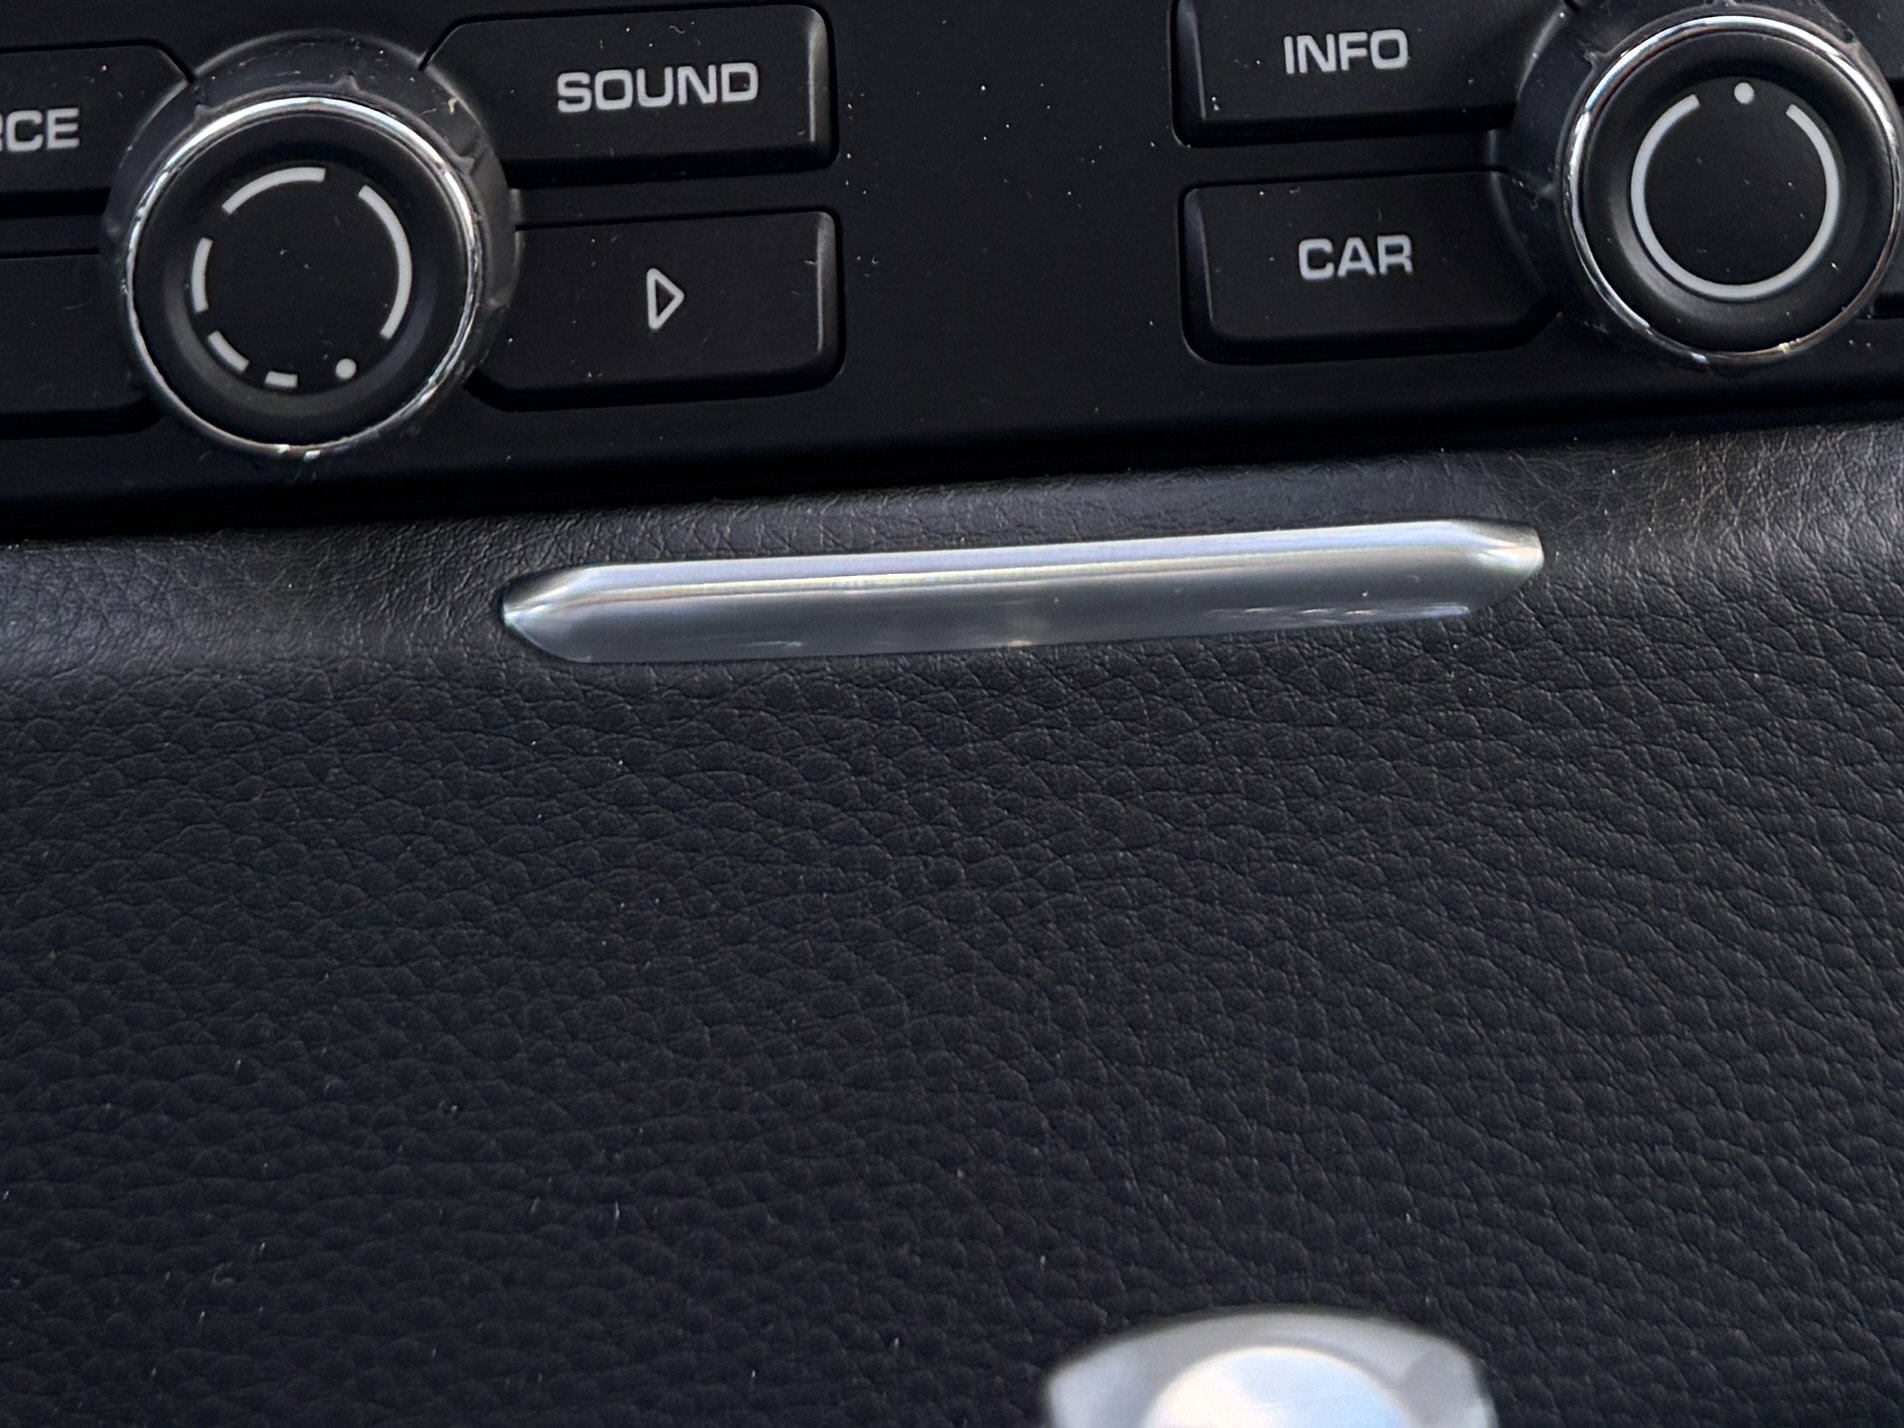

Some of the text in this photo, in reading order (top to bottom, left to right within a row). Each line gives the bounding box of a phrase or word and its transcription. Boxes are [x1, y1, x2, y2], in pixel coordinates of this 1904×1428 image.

[1283, 28, 1409, 75] INFO
[555, 61, 760, 116] SOUND
[1298, 236, 1414, 282] CAR
